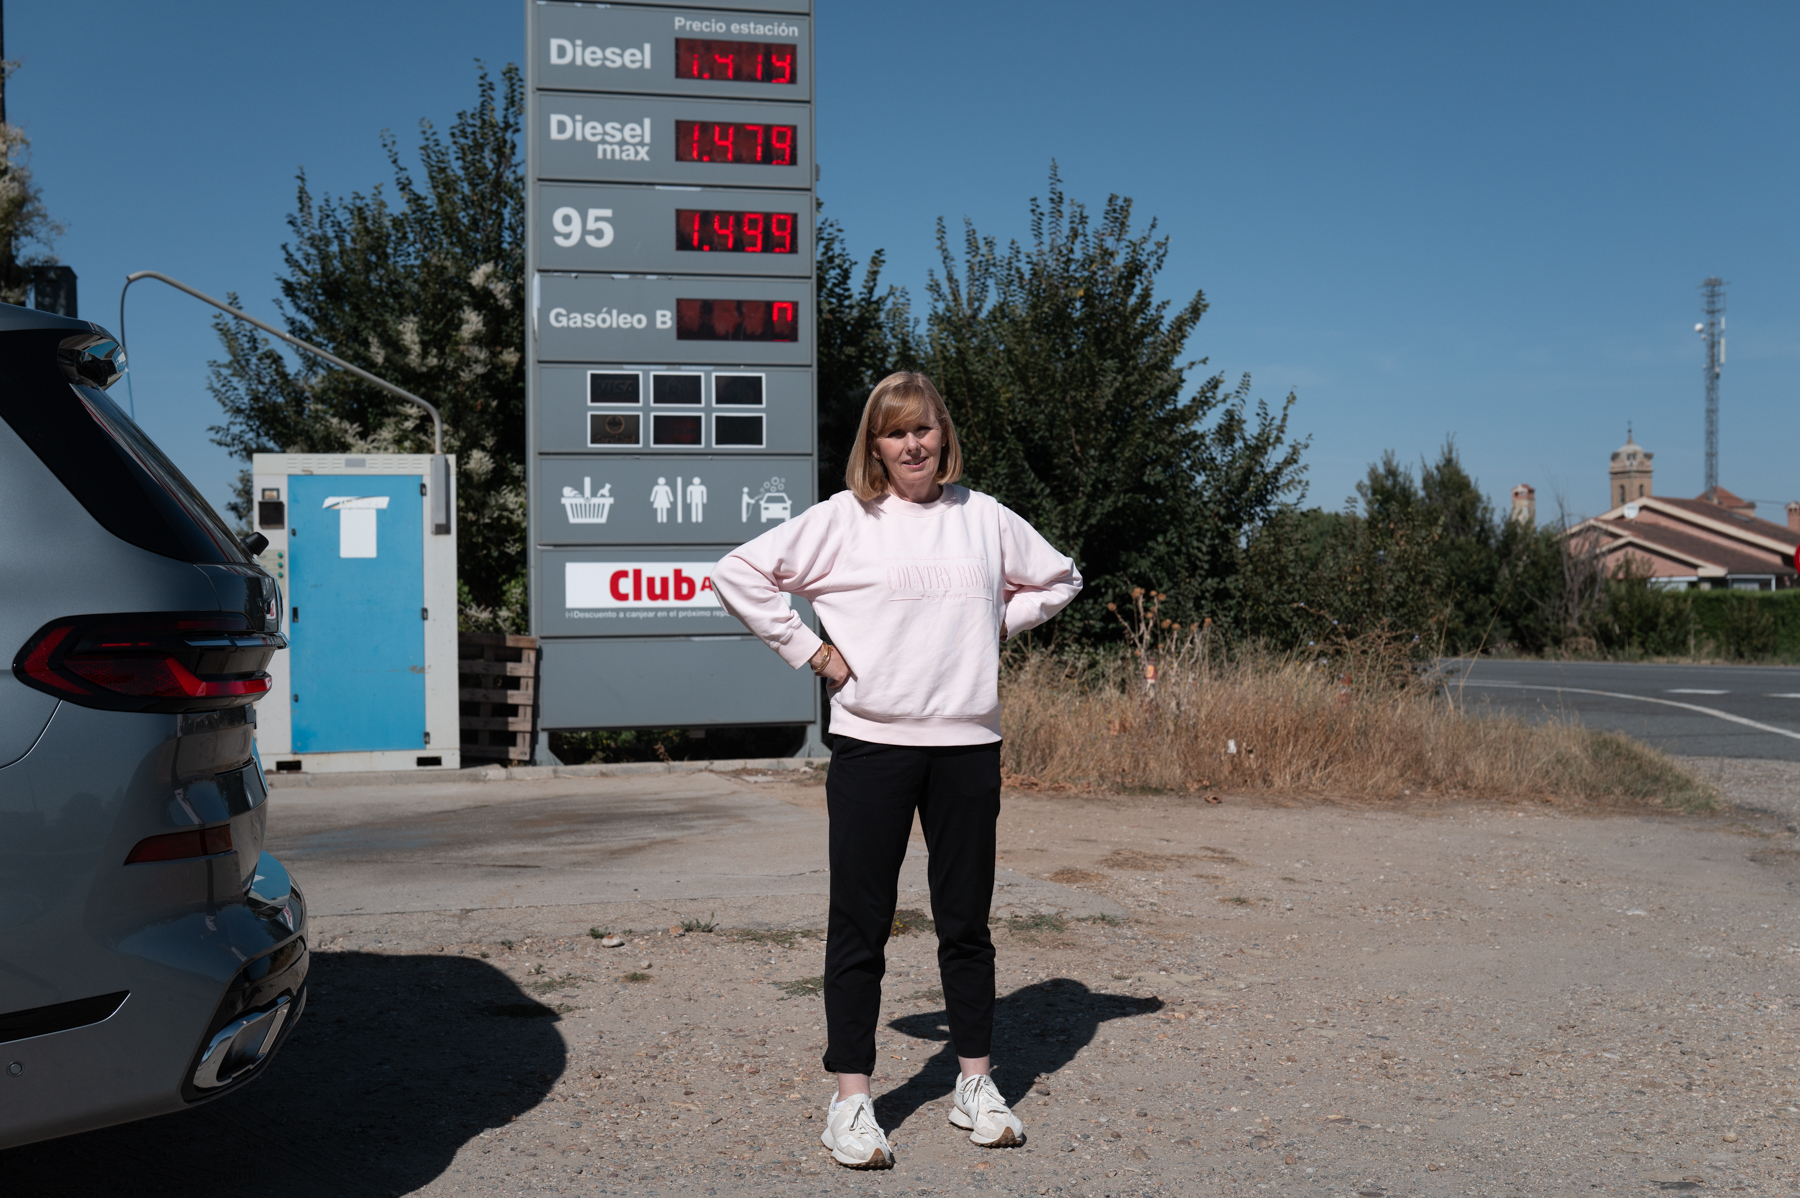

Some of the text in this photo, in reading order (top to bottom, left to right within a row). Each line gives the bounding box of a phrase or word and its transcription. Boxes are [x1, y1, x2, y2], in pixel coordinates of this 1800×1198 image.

[674, 16, 799, 37] Precio estación
[549, 37, 652, 69] Diesel
[549, 113, 652, 144] Diesel
[597, 144, 650, 161] max
[692, 123, 793, 166] 1.479
[552, 206, 615, 249] 95
[692, 211, 793, 253] 1.499
[548, 307, 673, 329] Gasóleo B
[609, 568, 714, 602] Club A
[626, 610, 655, 620] canjear
[669, 610, 678, 618] el
